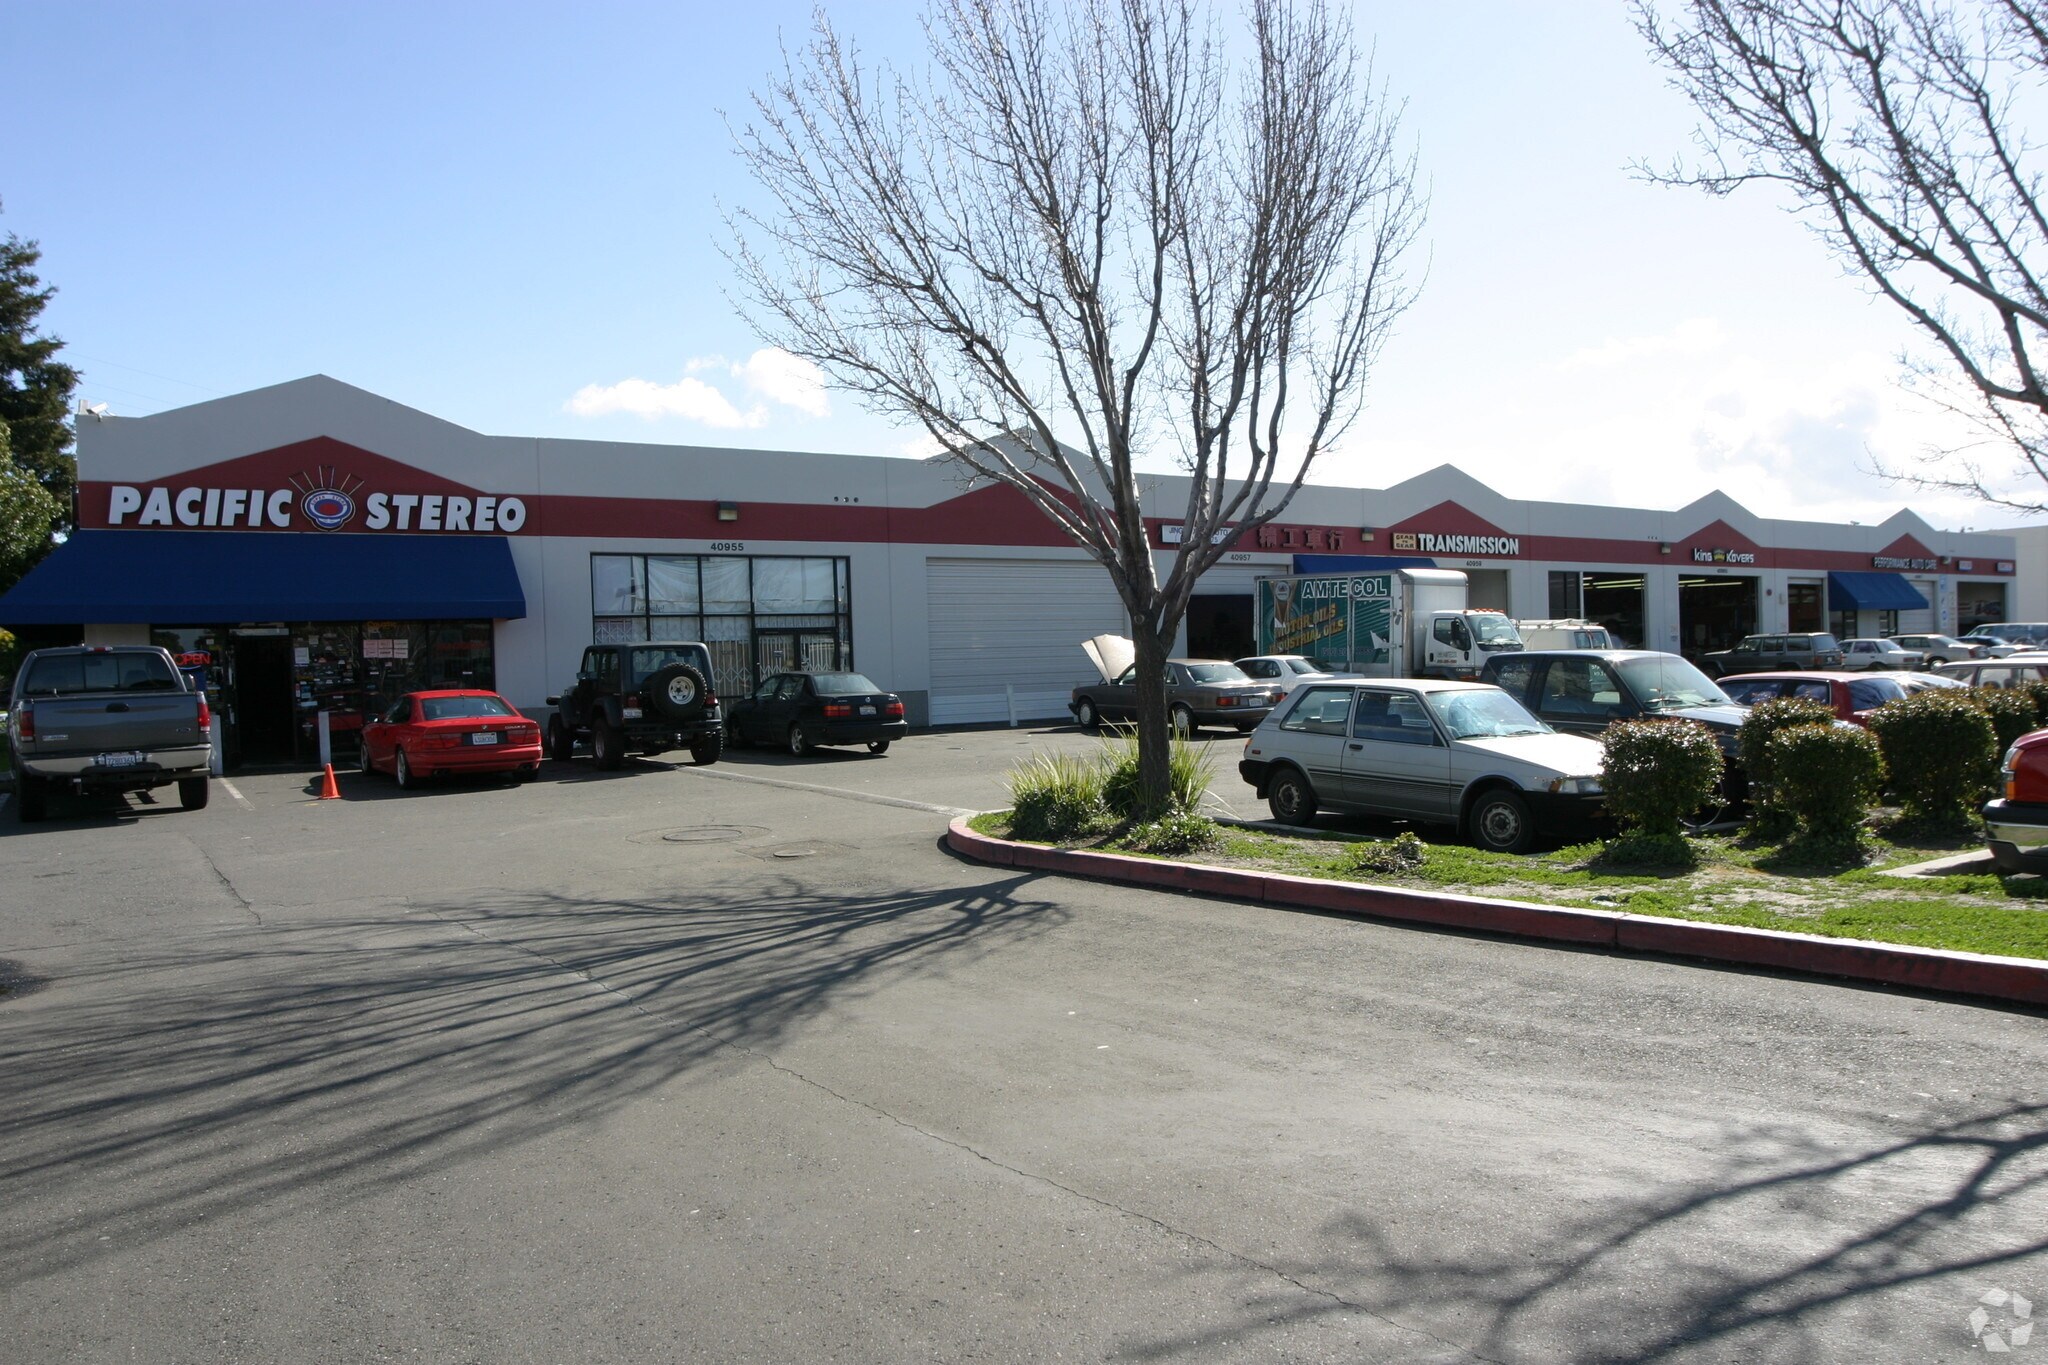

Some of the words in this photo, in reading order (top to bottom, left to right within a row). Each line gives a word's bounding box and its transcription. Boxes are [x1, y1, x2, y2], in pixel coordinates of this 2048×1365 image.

[108, 485, 293, 527] PACIFIC
[365, 492, 527, 533] STEREO
[710, 542, 744, 551] 40955
[1418, 533, 1519, 555] TRANSMISSION
[1230, 553, 1251, 561] 40957
[1874, 556, 1910, 569] PERFORMANCE
[1911, 558, 1924, 569] AUTO
[1924, 559, 1937, 570] CARE
[1302, 578, 1388, 598] AMTECOL
[1275, 613, 1311, 640] MOTOR
[1312, 602, 1337, 625] OILS
[1269, 627, 1322, 656] INDUSTRIAL
[1323, 618, 1345, 637] OILS
[174, 653, 211, 666] OPEN
